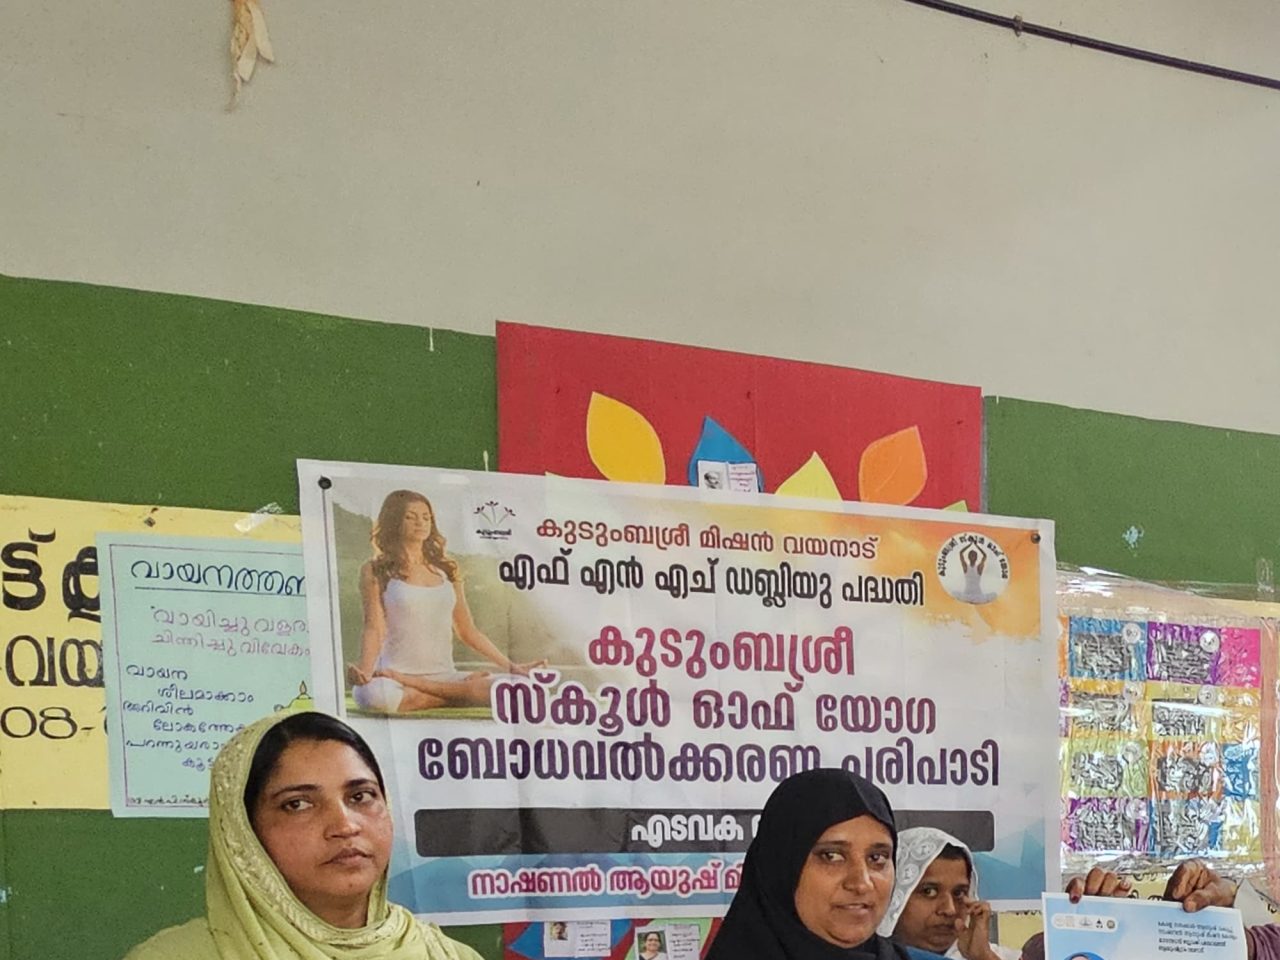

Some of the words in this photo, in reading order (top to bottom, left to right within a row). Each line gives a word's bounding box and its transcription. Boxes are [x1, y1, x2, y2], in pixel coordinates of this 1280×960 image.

[537, 519, 690, 550] കുടുംബശ്രീ
[700, 525, 774, 552] മിഷൻ
[784, 536, 879, 559] വയനാട്
[500, 547, 573, 590] എഫ്
[580, 555, 643, 594] എൻ
[588, 625, 855, 683] കുടുംബശ്രീ
[0, 706, 108, 740] 08-
[495, 672, 671, 736] സ്കൂൾ
[692, 681, 804, 731] ഓഫ്
[815, 693, 937, 734] യോഗ
[418, 732, 821, 783] ബോധവൽക്കരണ
[841, 736, 999, 787] പരിപാടി
[631, 814, 744, 848] എടവക
[471, 865, 602, 895] നാഷണൽ
[609, 862, 721, 896] ആയുഷ്
